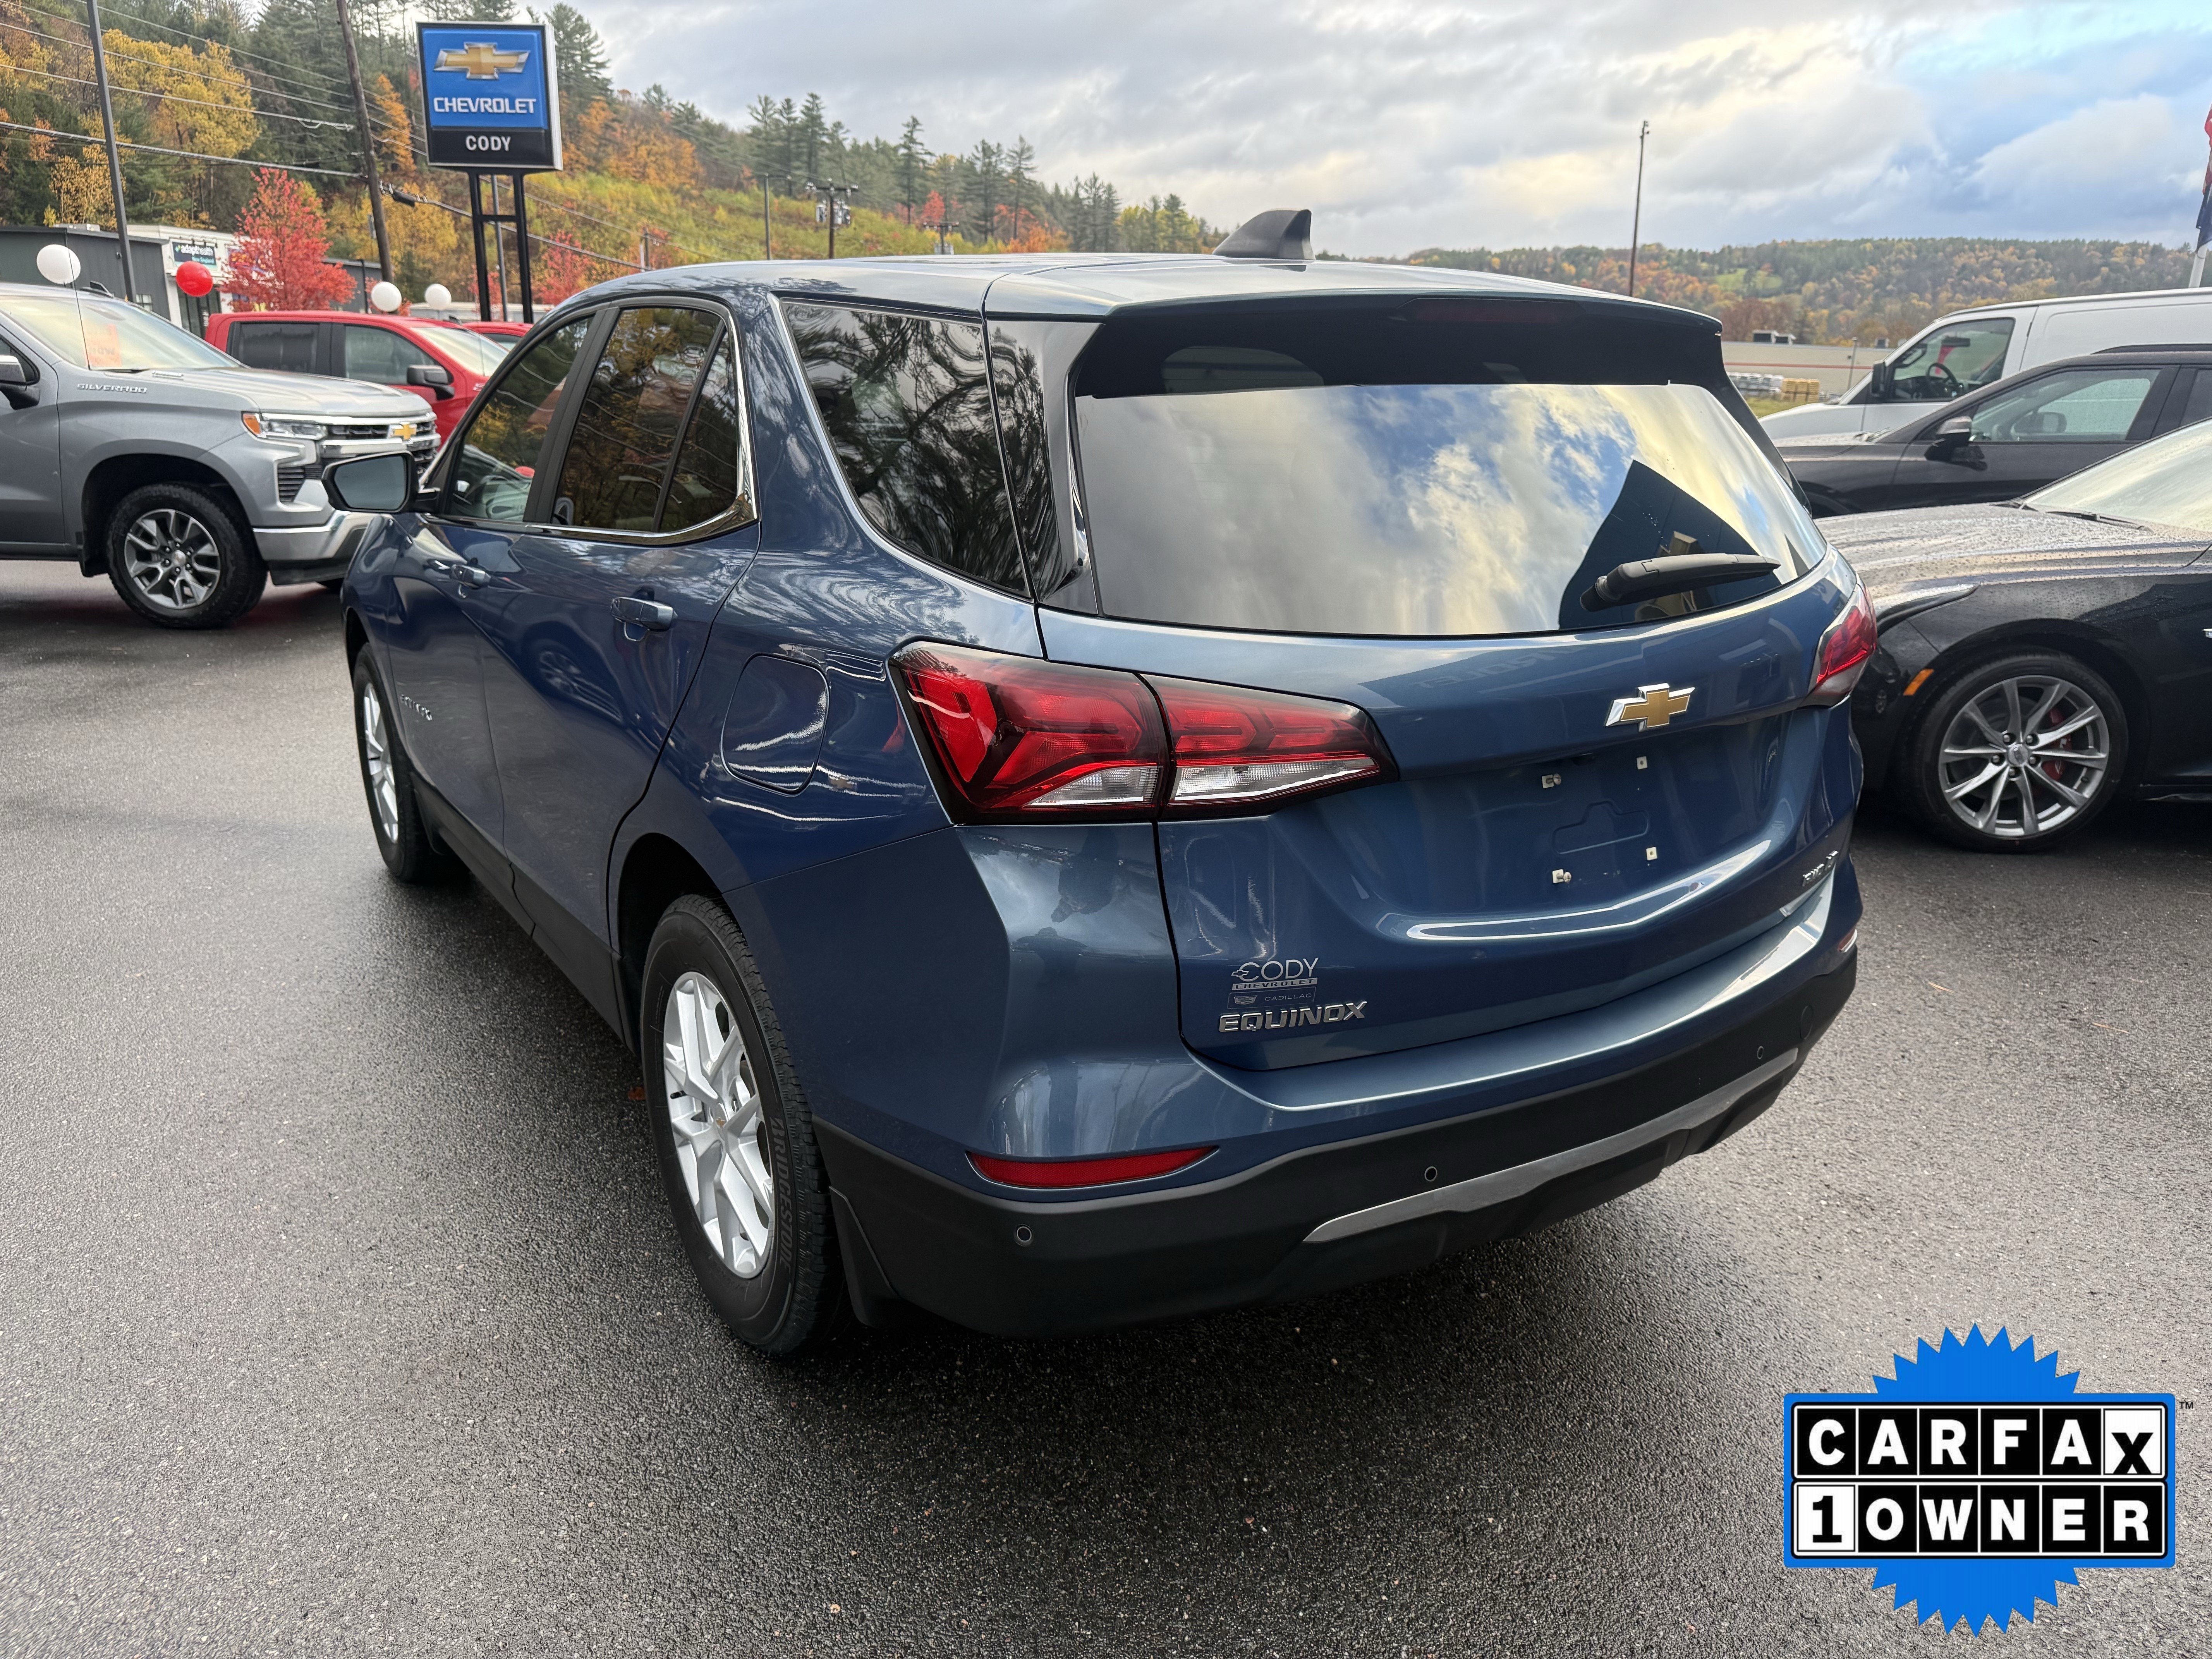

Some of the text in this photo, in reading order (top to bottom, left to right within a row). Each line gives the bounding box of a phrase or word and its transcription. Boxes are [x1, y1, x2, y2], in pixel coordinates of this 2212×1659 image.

[433, 97, 536, 113] CHEVROLET
[465, 135, 511, 151] CODY
[77, 383, 147, 393] SILVERADO
[1238, 957, 1319, 982] CODY
[1235, 979, 1314, 990] CHEVROLET
[1264, 993, 1312, 1001] CADILLAC
[1219, 1001, 1367, 1033] EQUINOX
[770, 1117, 793, 1274] BRIDGESTONE
